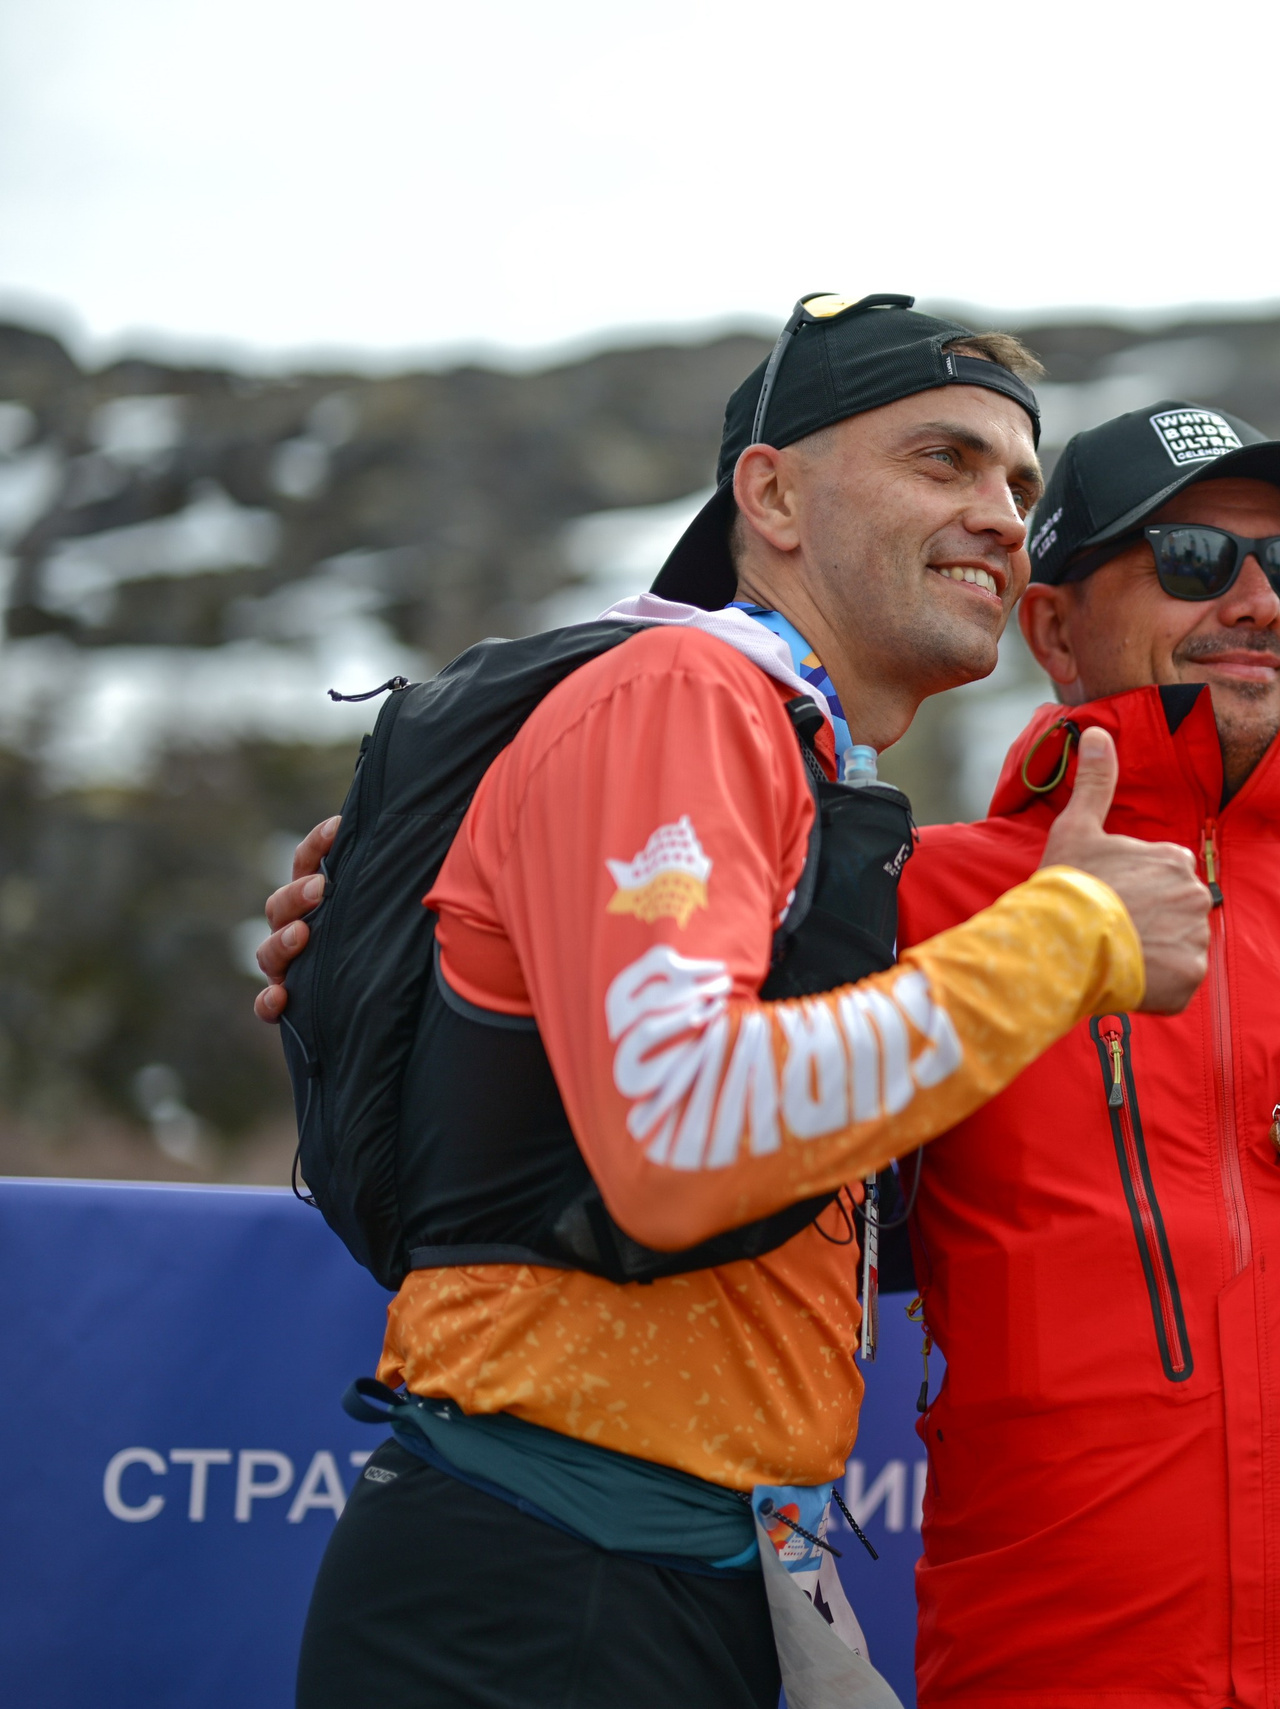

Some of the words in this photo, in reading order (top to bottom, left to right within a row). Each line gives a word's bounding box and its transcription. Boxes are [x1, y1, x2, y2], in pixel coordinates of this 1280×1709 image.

[1156, 413, 1228, 428] WHITE
[1163, 424, 1234, 440] BRIDE
[1169, 436, 1240, 452] ULTRA
